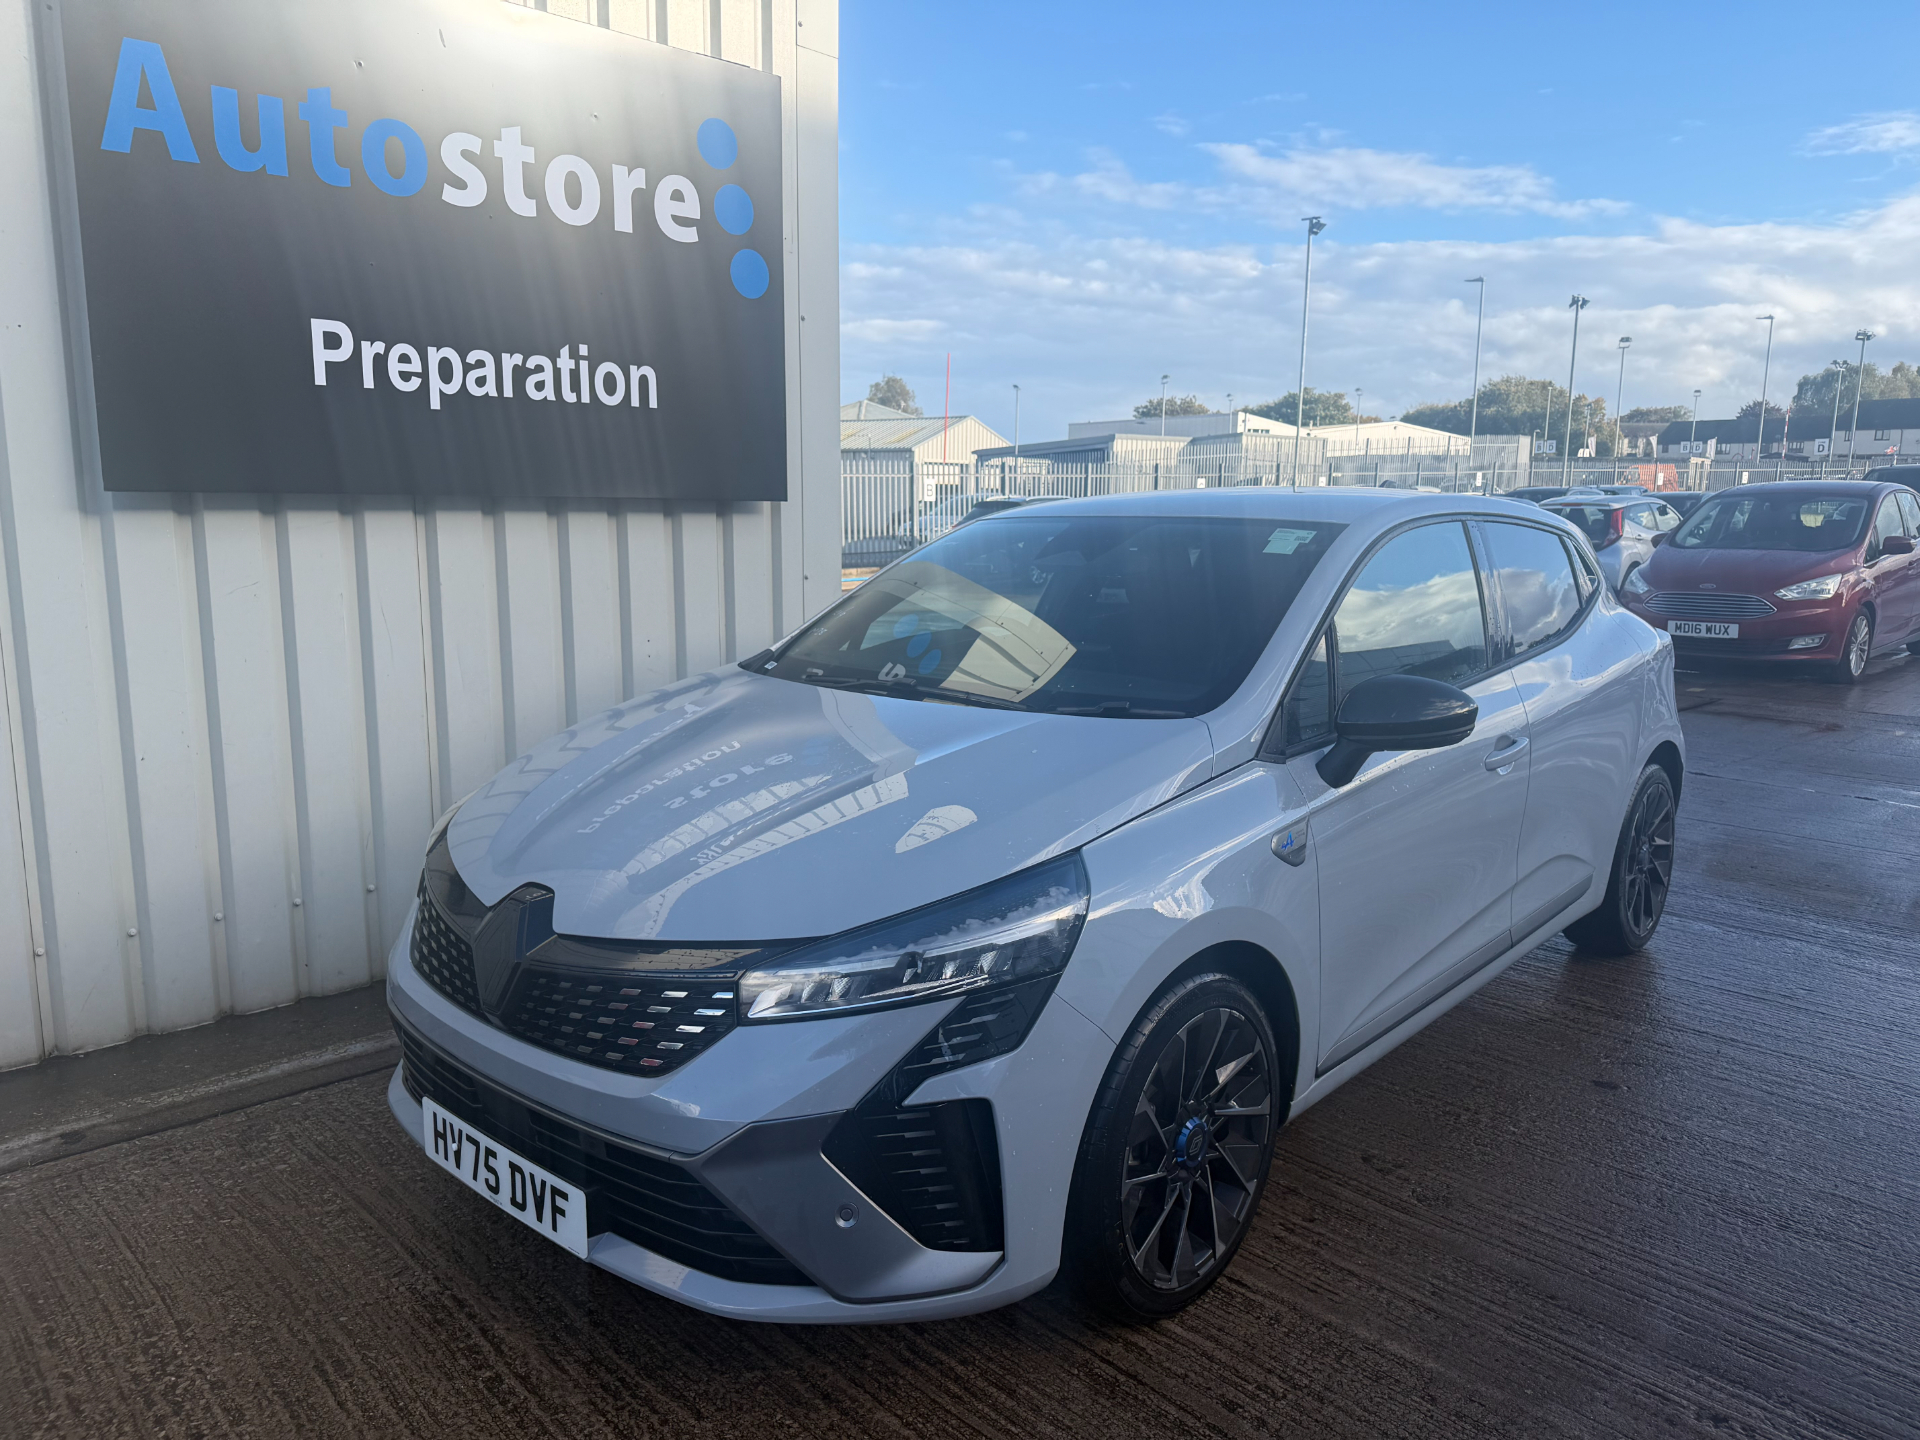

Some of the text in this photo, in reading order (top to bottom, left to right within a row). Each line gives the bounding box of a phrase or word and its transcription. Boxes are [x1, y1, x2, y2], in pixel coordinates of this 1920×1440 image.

[100, 36, 702, 243] Autostore
[310, 318, 659, 410] Preparation
[1817, 444, 1825, 453] D
[926, 483, 934, 497] B
[1674, 622, 1731, 636] MD16 WUX
[432, 1110, 570, 1234] HV75 DVF
